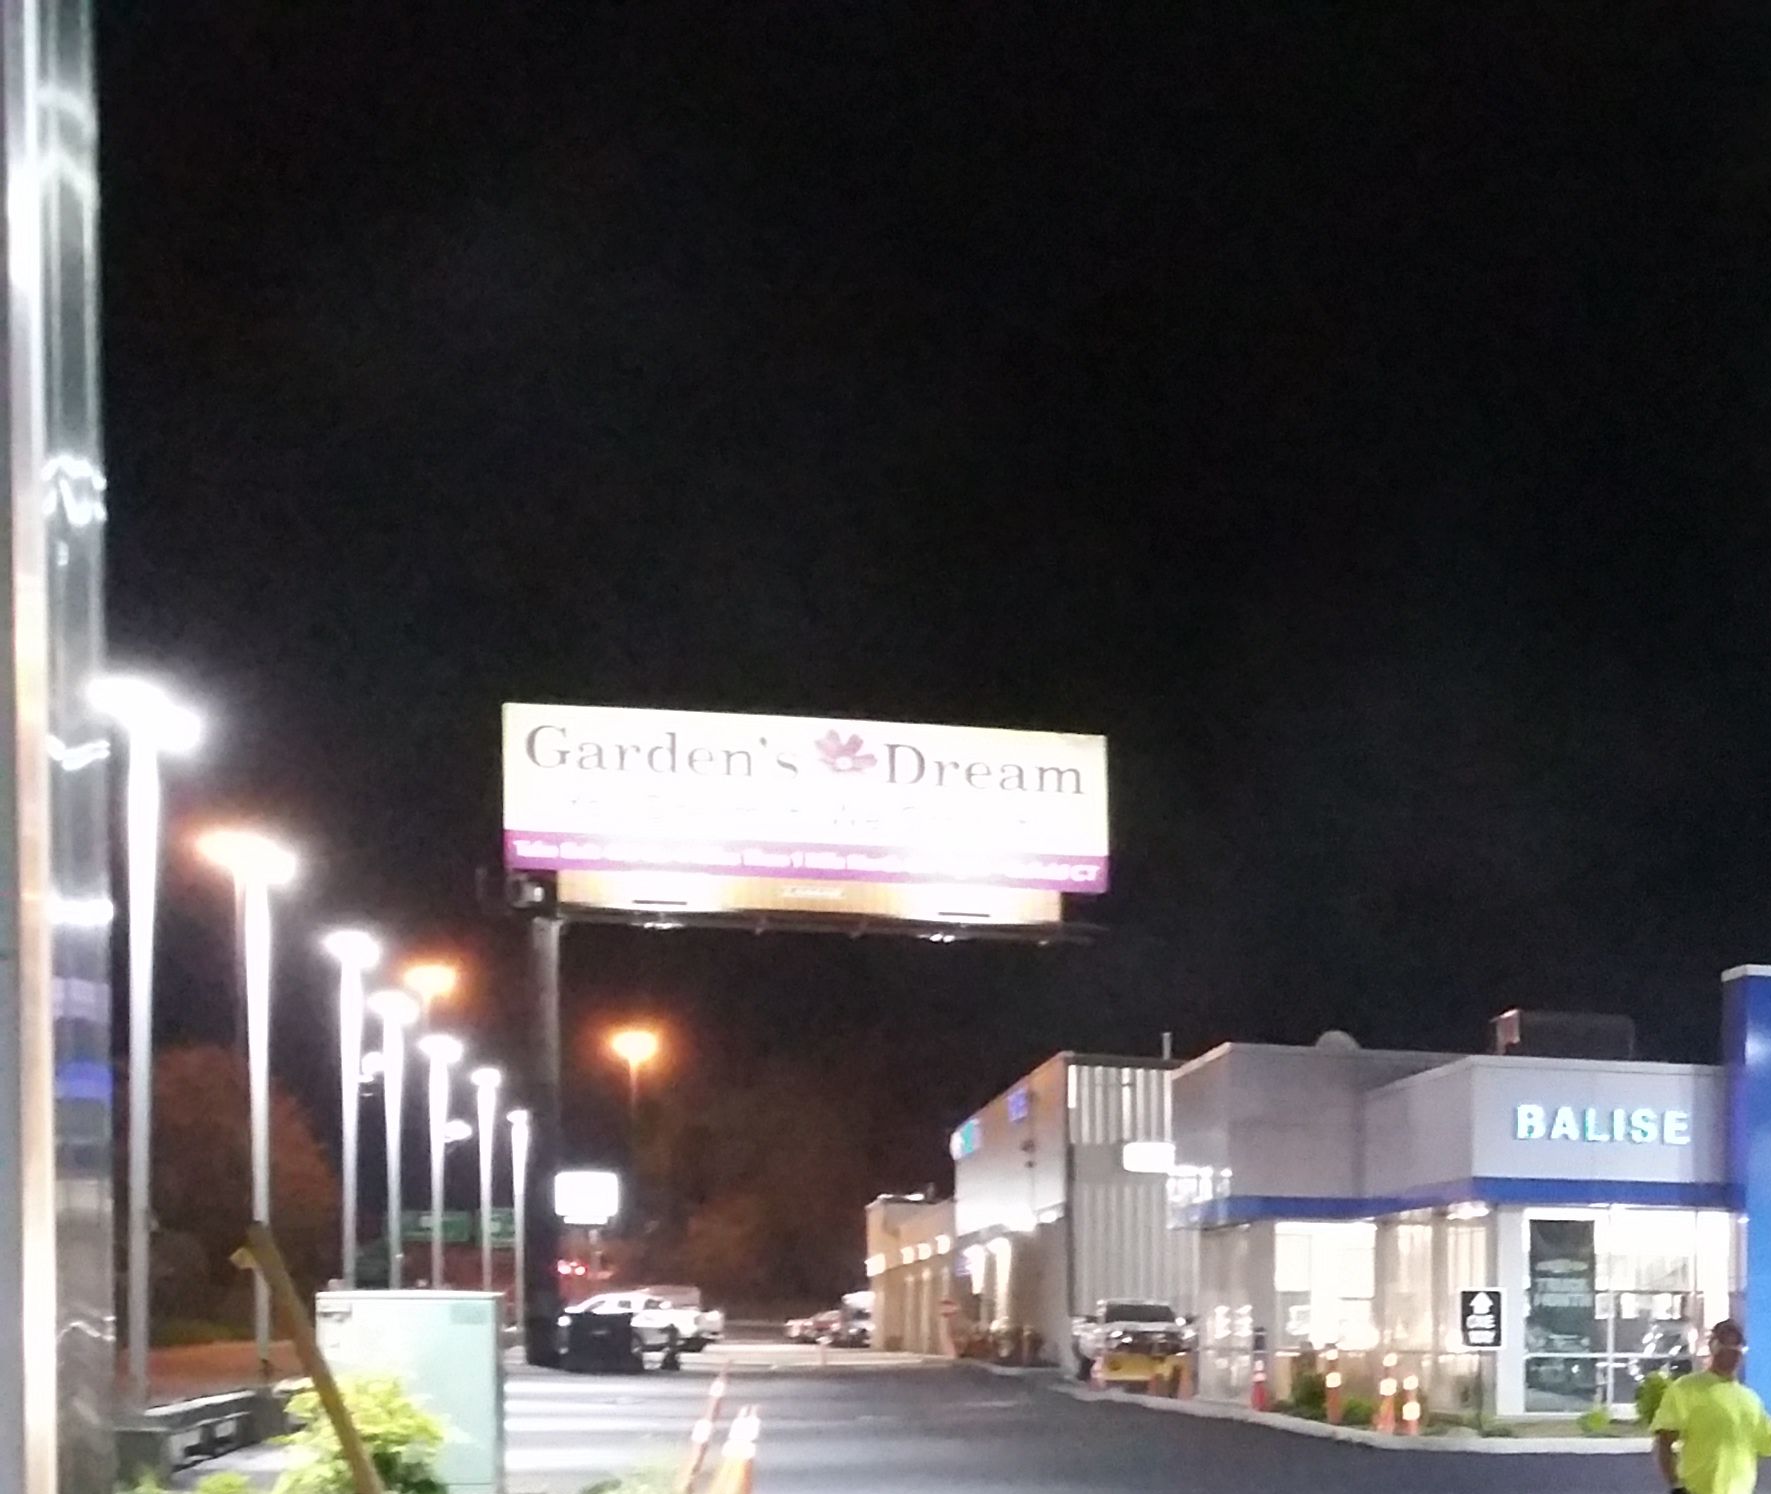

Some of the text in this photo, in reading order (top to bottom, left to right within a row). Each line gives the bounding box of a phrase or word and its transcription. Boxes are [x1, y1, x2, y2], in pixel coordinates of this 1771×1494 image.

[524, 724, 1086, 795] Garden's Dream
[1516, 1103, 1692, 1145] BALISE
